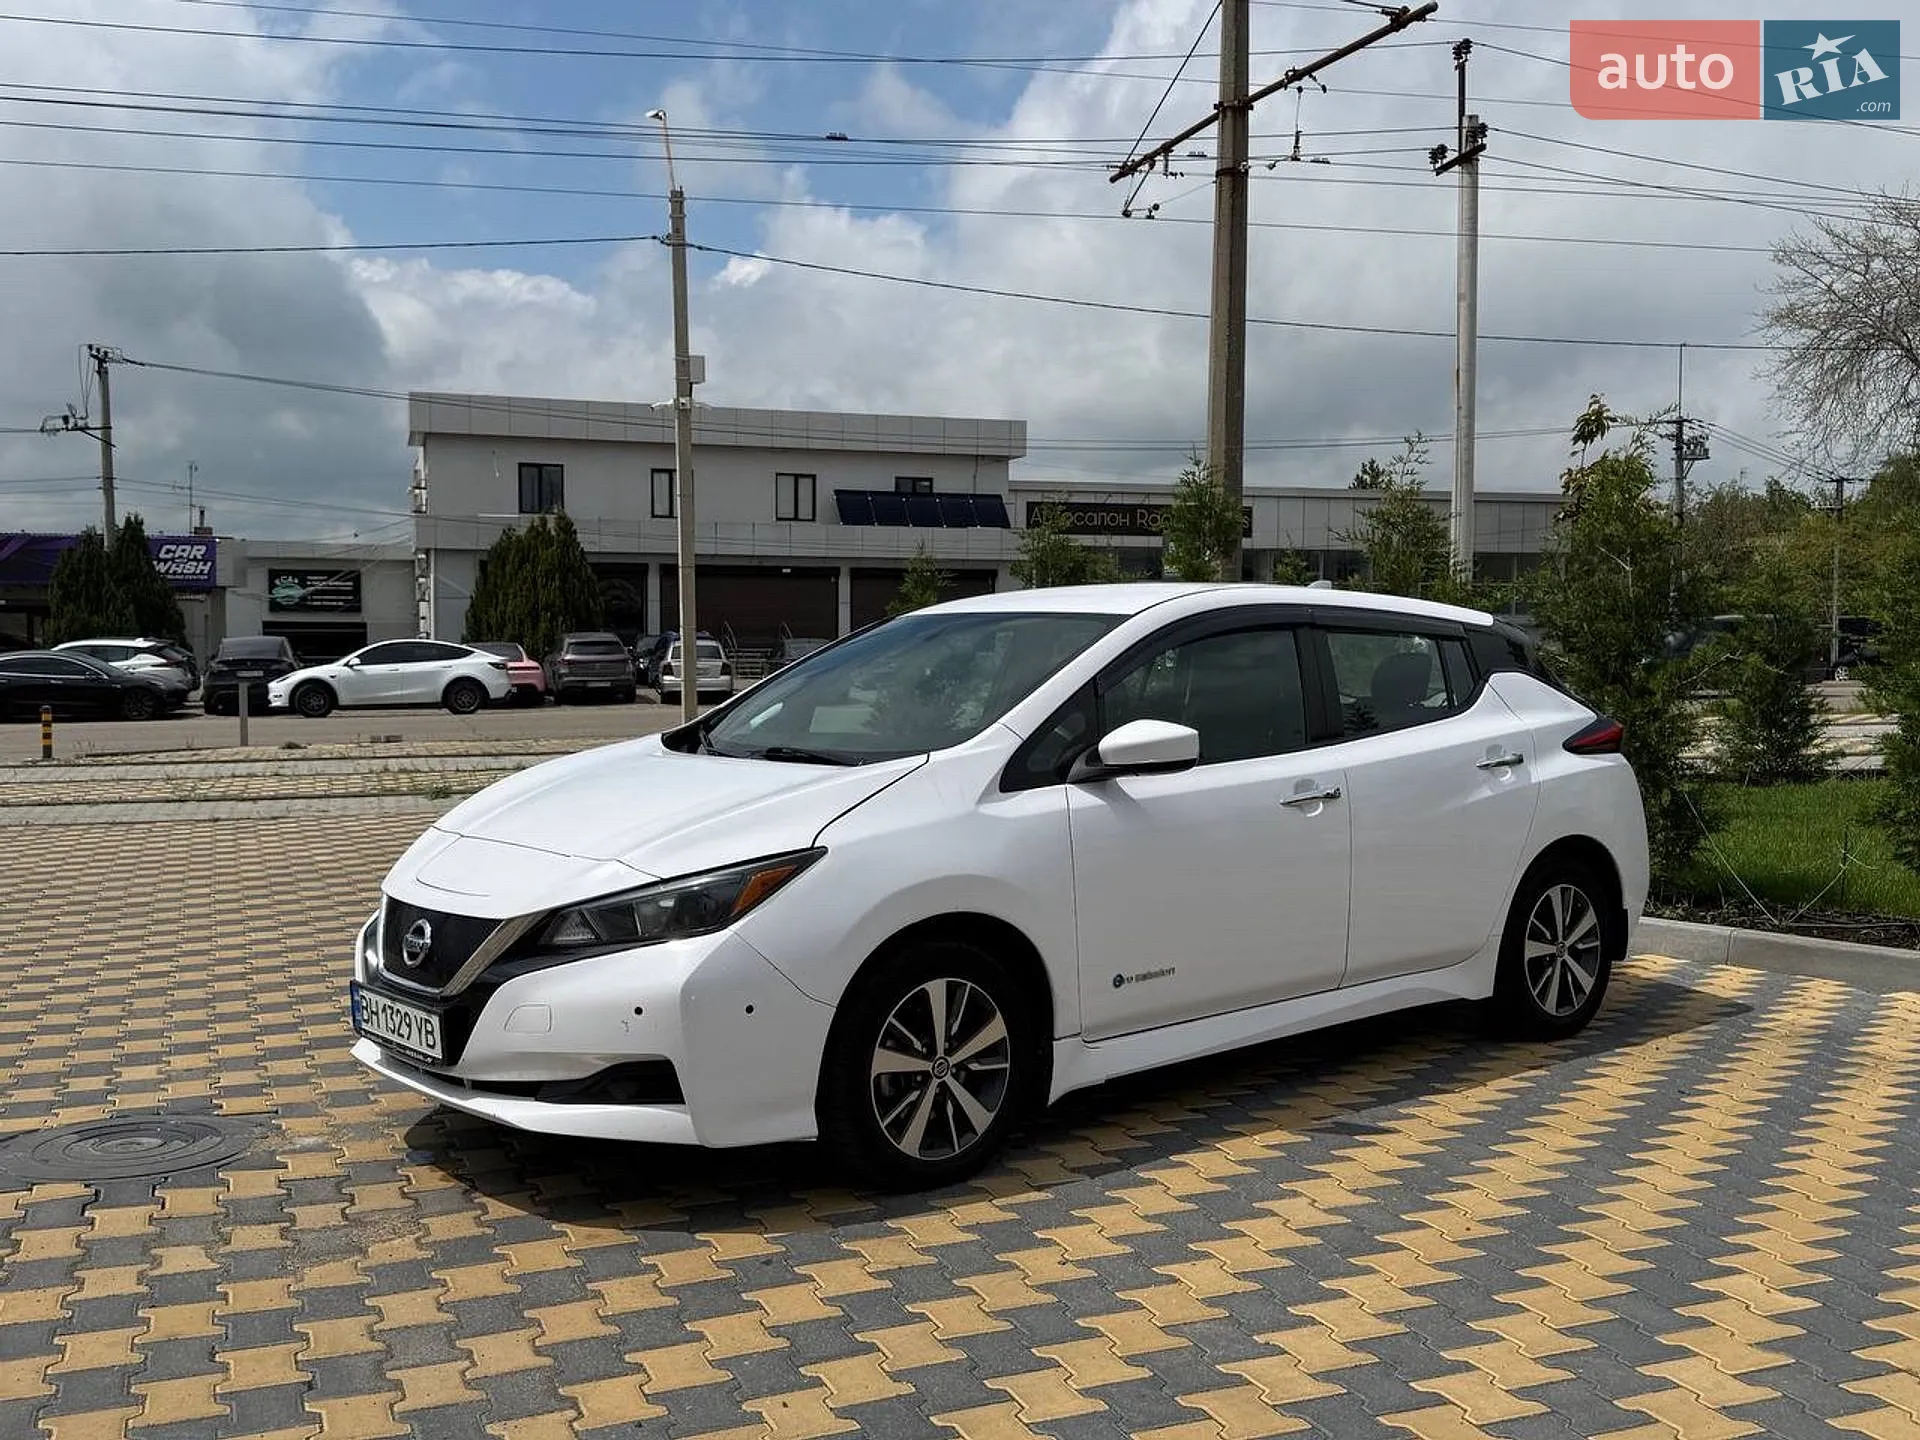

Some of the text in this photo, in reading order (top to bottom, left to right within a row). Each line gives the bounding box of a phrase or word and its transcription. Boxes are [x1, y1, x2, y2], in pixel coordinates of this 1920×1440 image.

[158, 544, 207, 560] CAR
[151, 560, 213, 575] WASH
[381, 1003, 412, 1041] 1329
